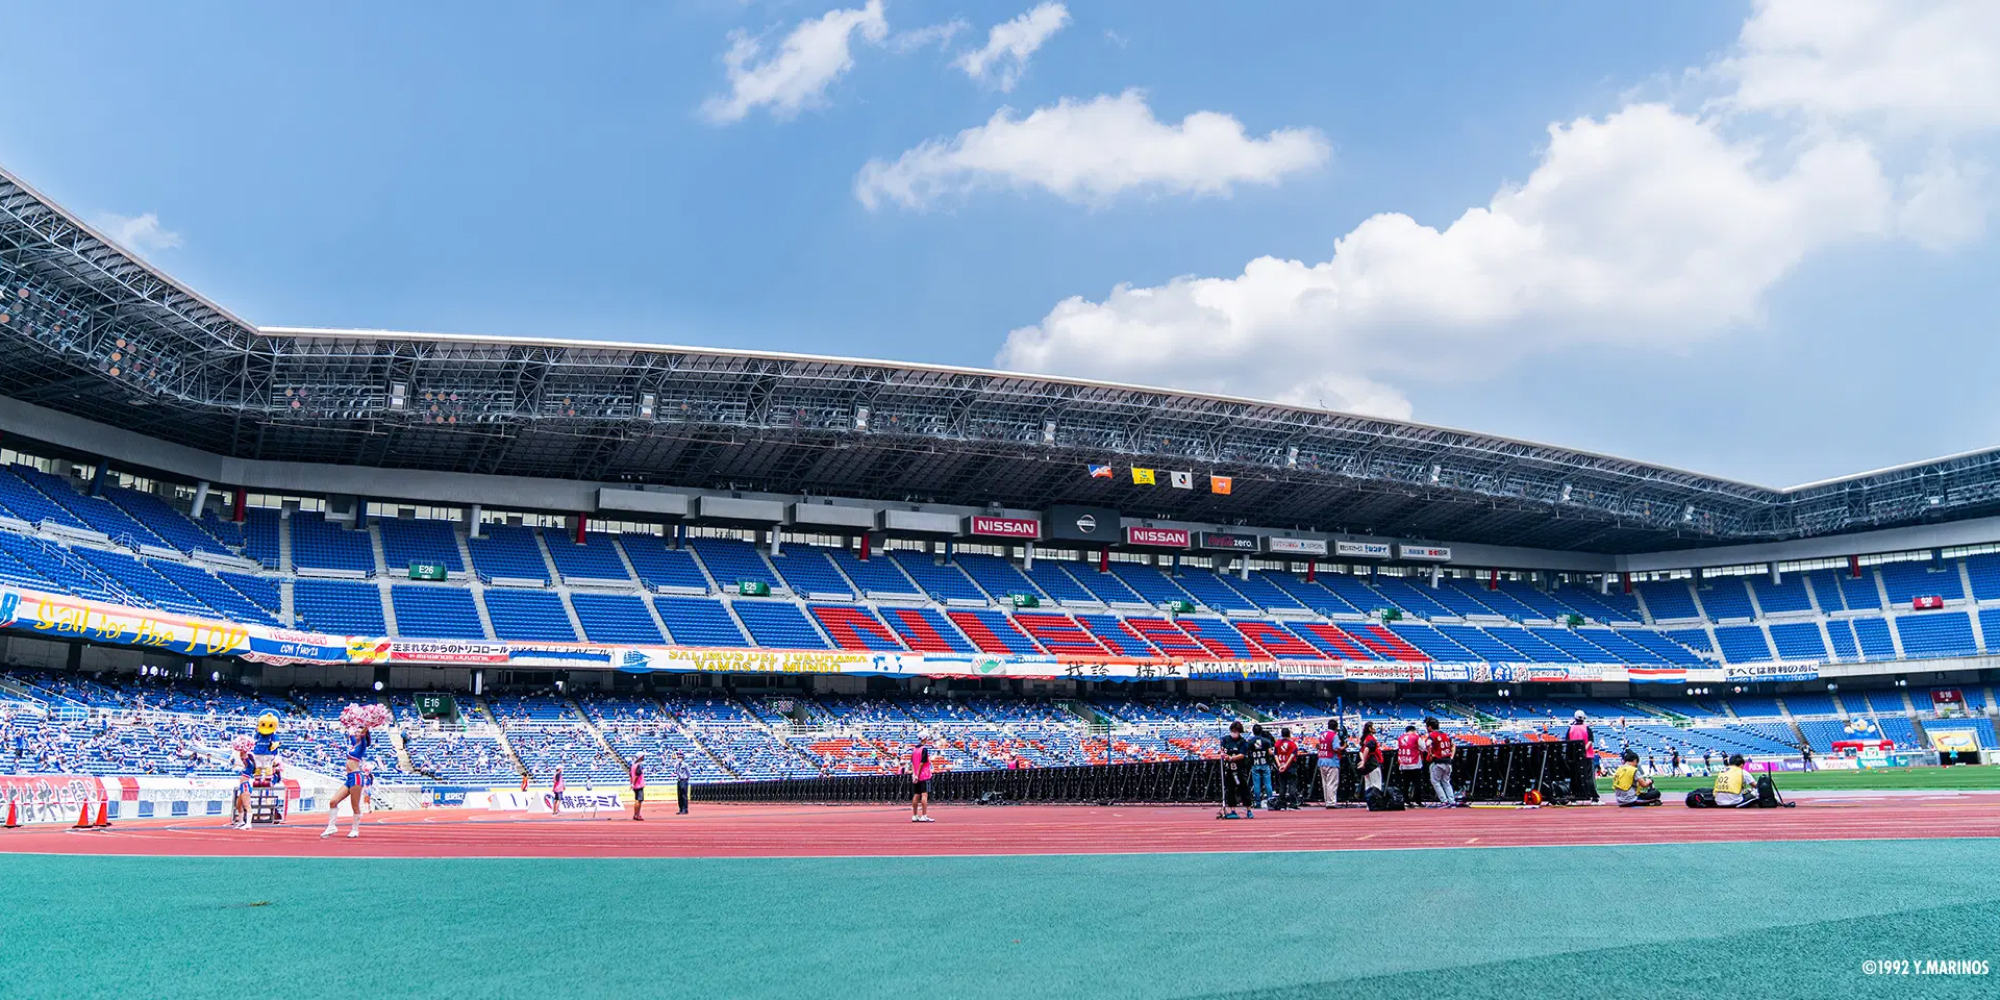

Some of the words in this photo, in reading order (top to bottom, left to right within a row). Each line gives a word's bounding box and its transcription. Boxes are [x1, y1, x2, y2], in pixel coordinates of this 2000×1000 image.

[978, 520, 1034, 534] NISSAN
[1134, 530, 1185, 543] NISSAN
[419, 565, 434, 574] E26
[34, 594, 91, 634] Sail
[96, 613, 128, 639] for
[131, 617, 175, 647] the
[184, 621, 250, 654] TOP
[392, 643, 510, 655] 生まれながらのトリコロール
[669, 650, 744, 662] SALIMOS
[747, 651, 778, 663] DEL
[695, 659, 751, 673] VAMOS
[757, 661, 778, 673] AL
[782, 662, 842, 674] MUNDO
[424, 698, 440, 708] E16
